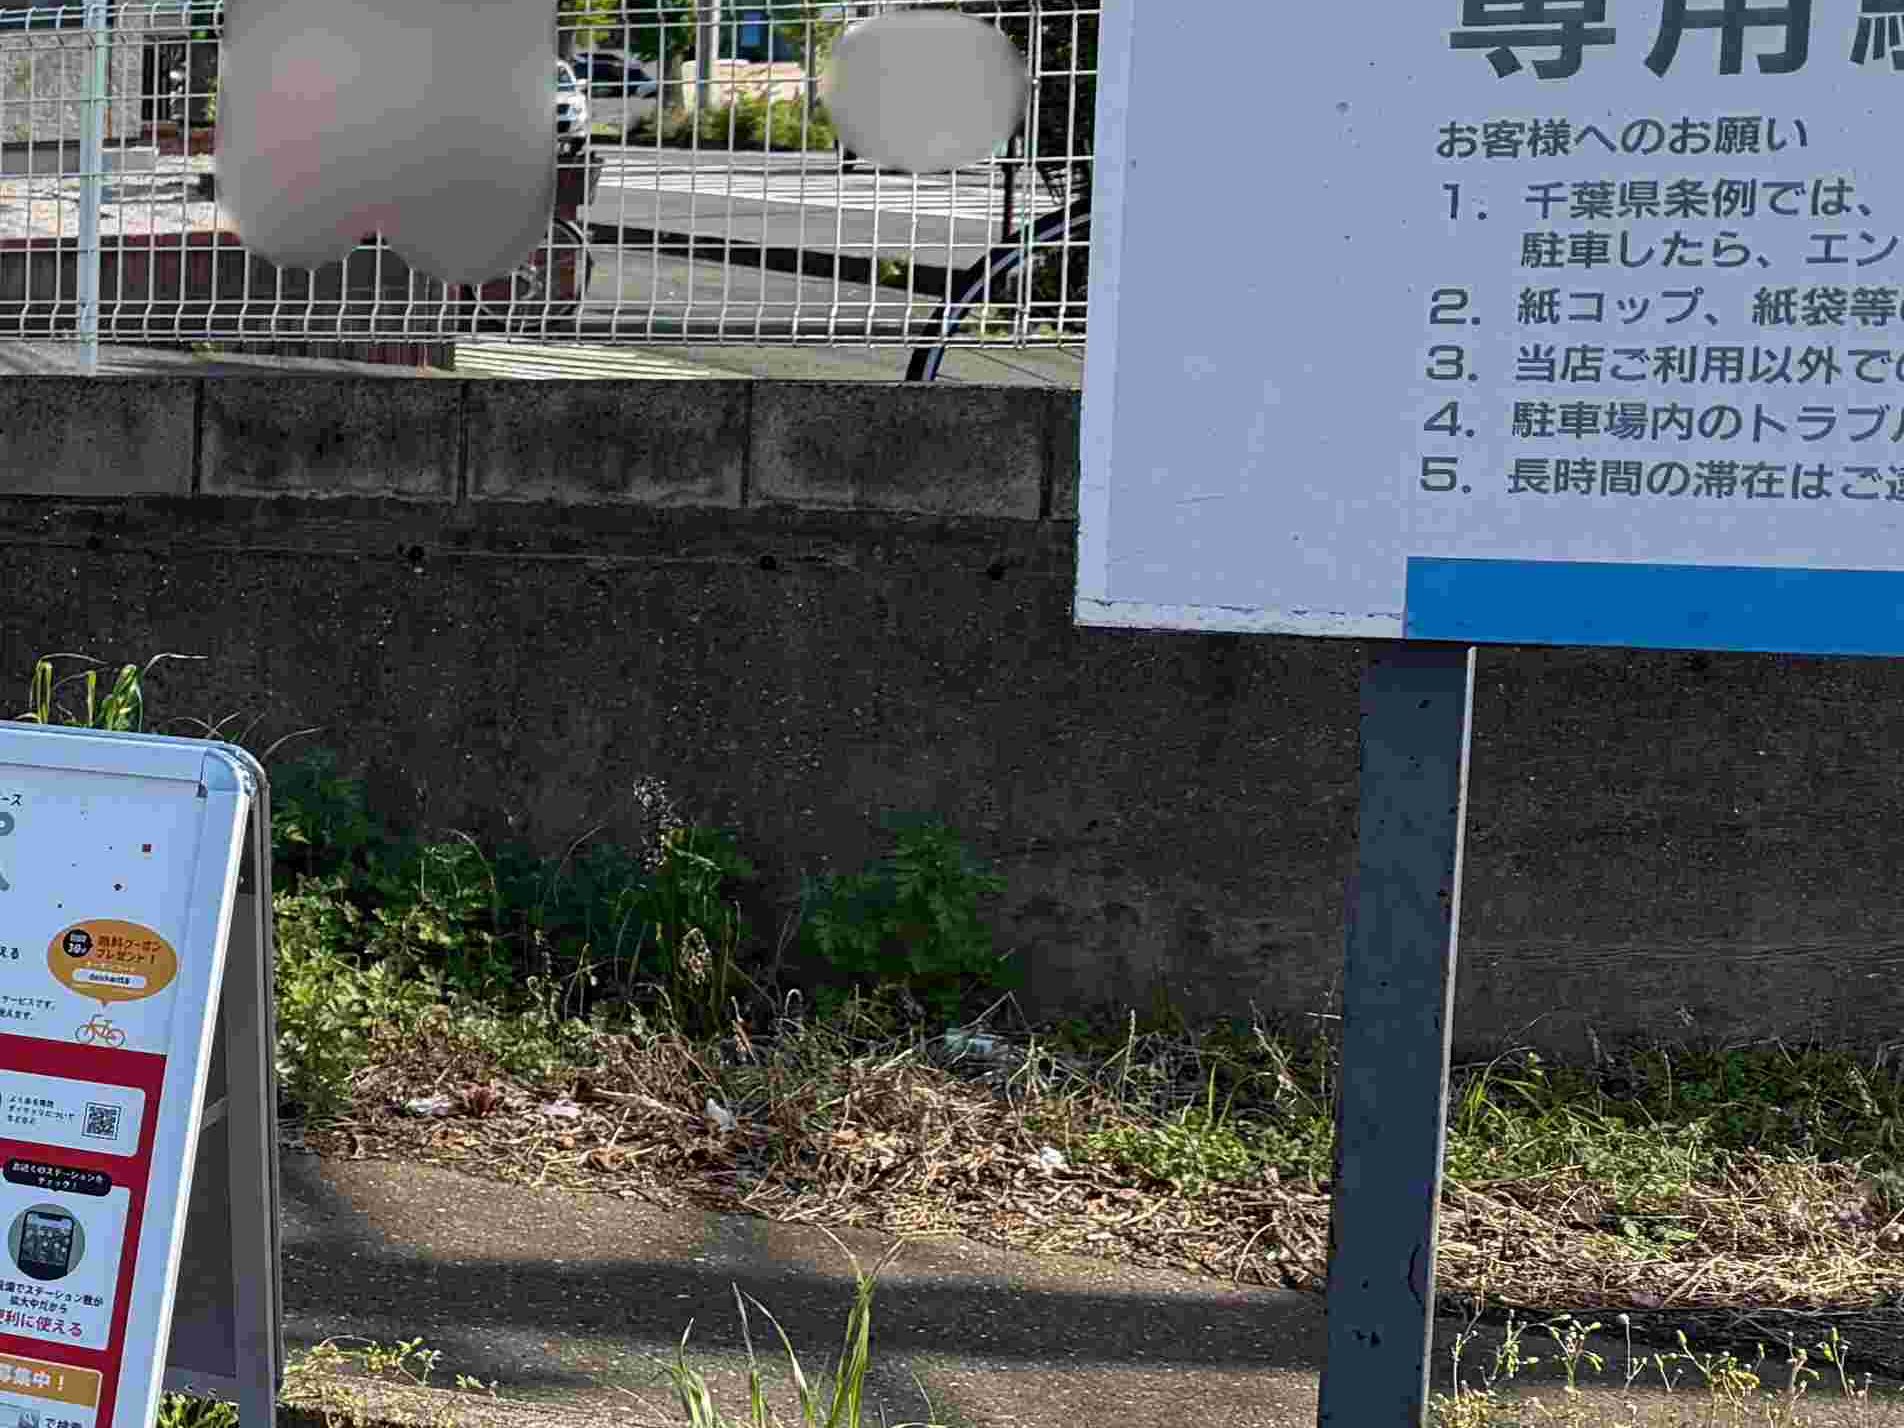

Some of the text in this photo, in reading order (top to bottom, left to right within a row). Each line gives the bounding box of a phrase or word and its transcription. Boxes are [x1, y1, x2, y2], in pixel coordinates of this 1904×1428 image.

[1435, 115, 1809, 159] お客様へのお願い
[1443, 178, 1871, 220] 1. 千葉県条例では、
[1429, 285, 1904, 326] 2. 紙コップ、紙袋等
[1425, 343, 1904, 385] 3. 当店ご利用以外で
[1423, 400, 1904, 443] 4. 駐車場内のトラブ
[1420, 456, 1472, 494] 5.
